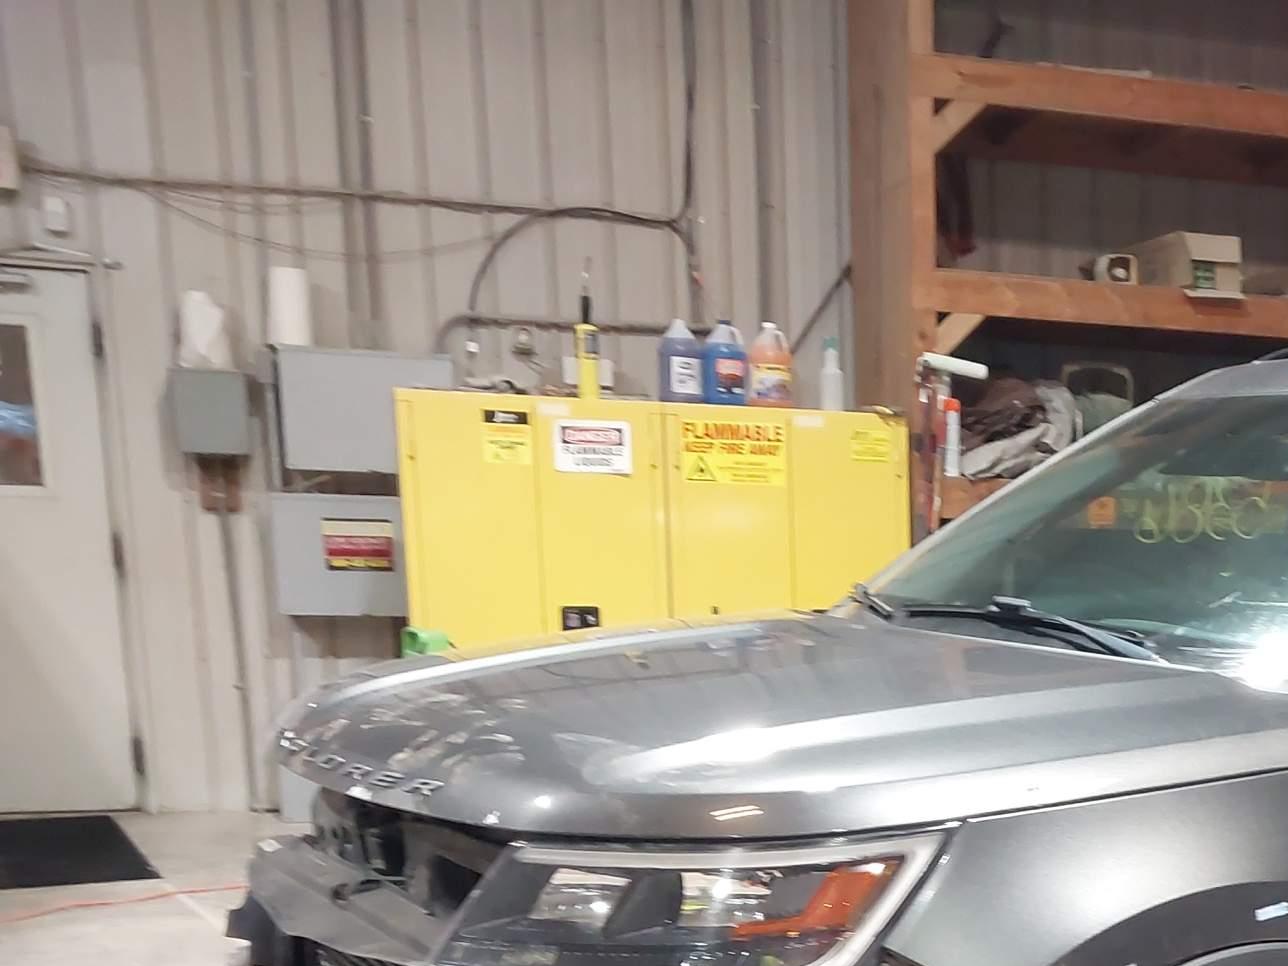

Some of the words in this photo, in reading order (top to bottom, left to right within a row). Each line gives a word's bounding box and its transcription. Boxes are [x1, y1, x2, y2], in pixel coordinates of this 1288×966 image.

[563, 428, 621, 445] DANGER
[681, 420, 785, 443] FLAMMABLE
[561, 444, 625, 457] FLAMMABLE
[718, 441, 747, 456] FIRE
[749, 442, 782, 457] AWAY
